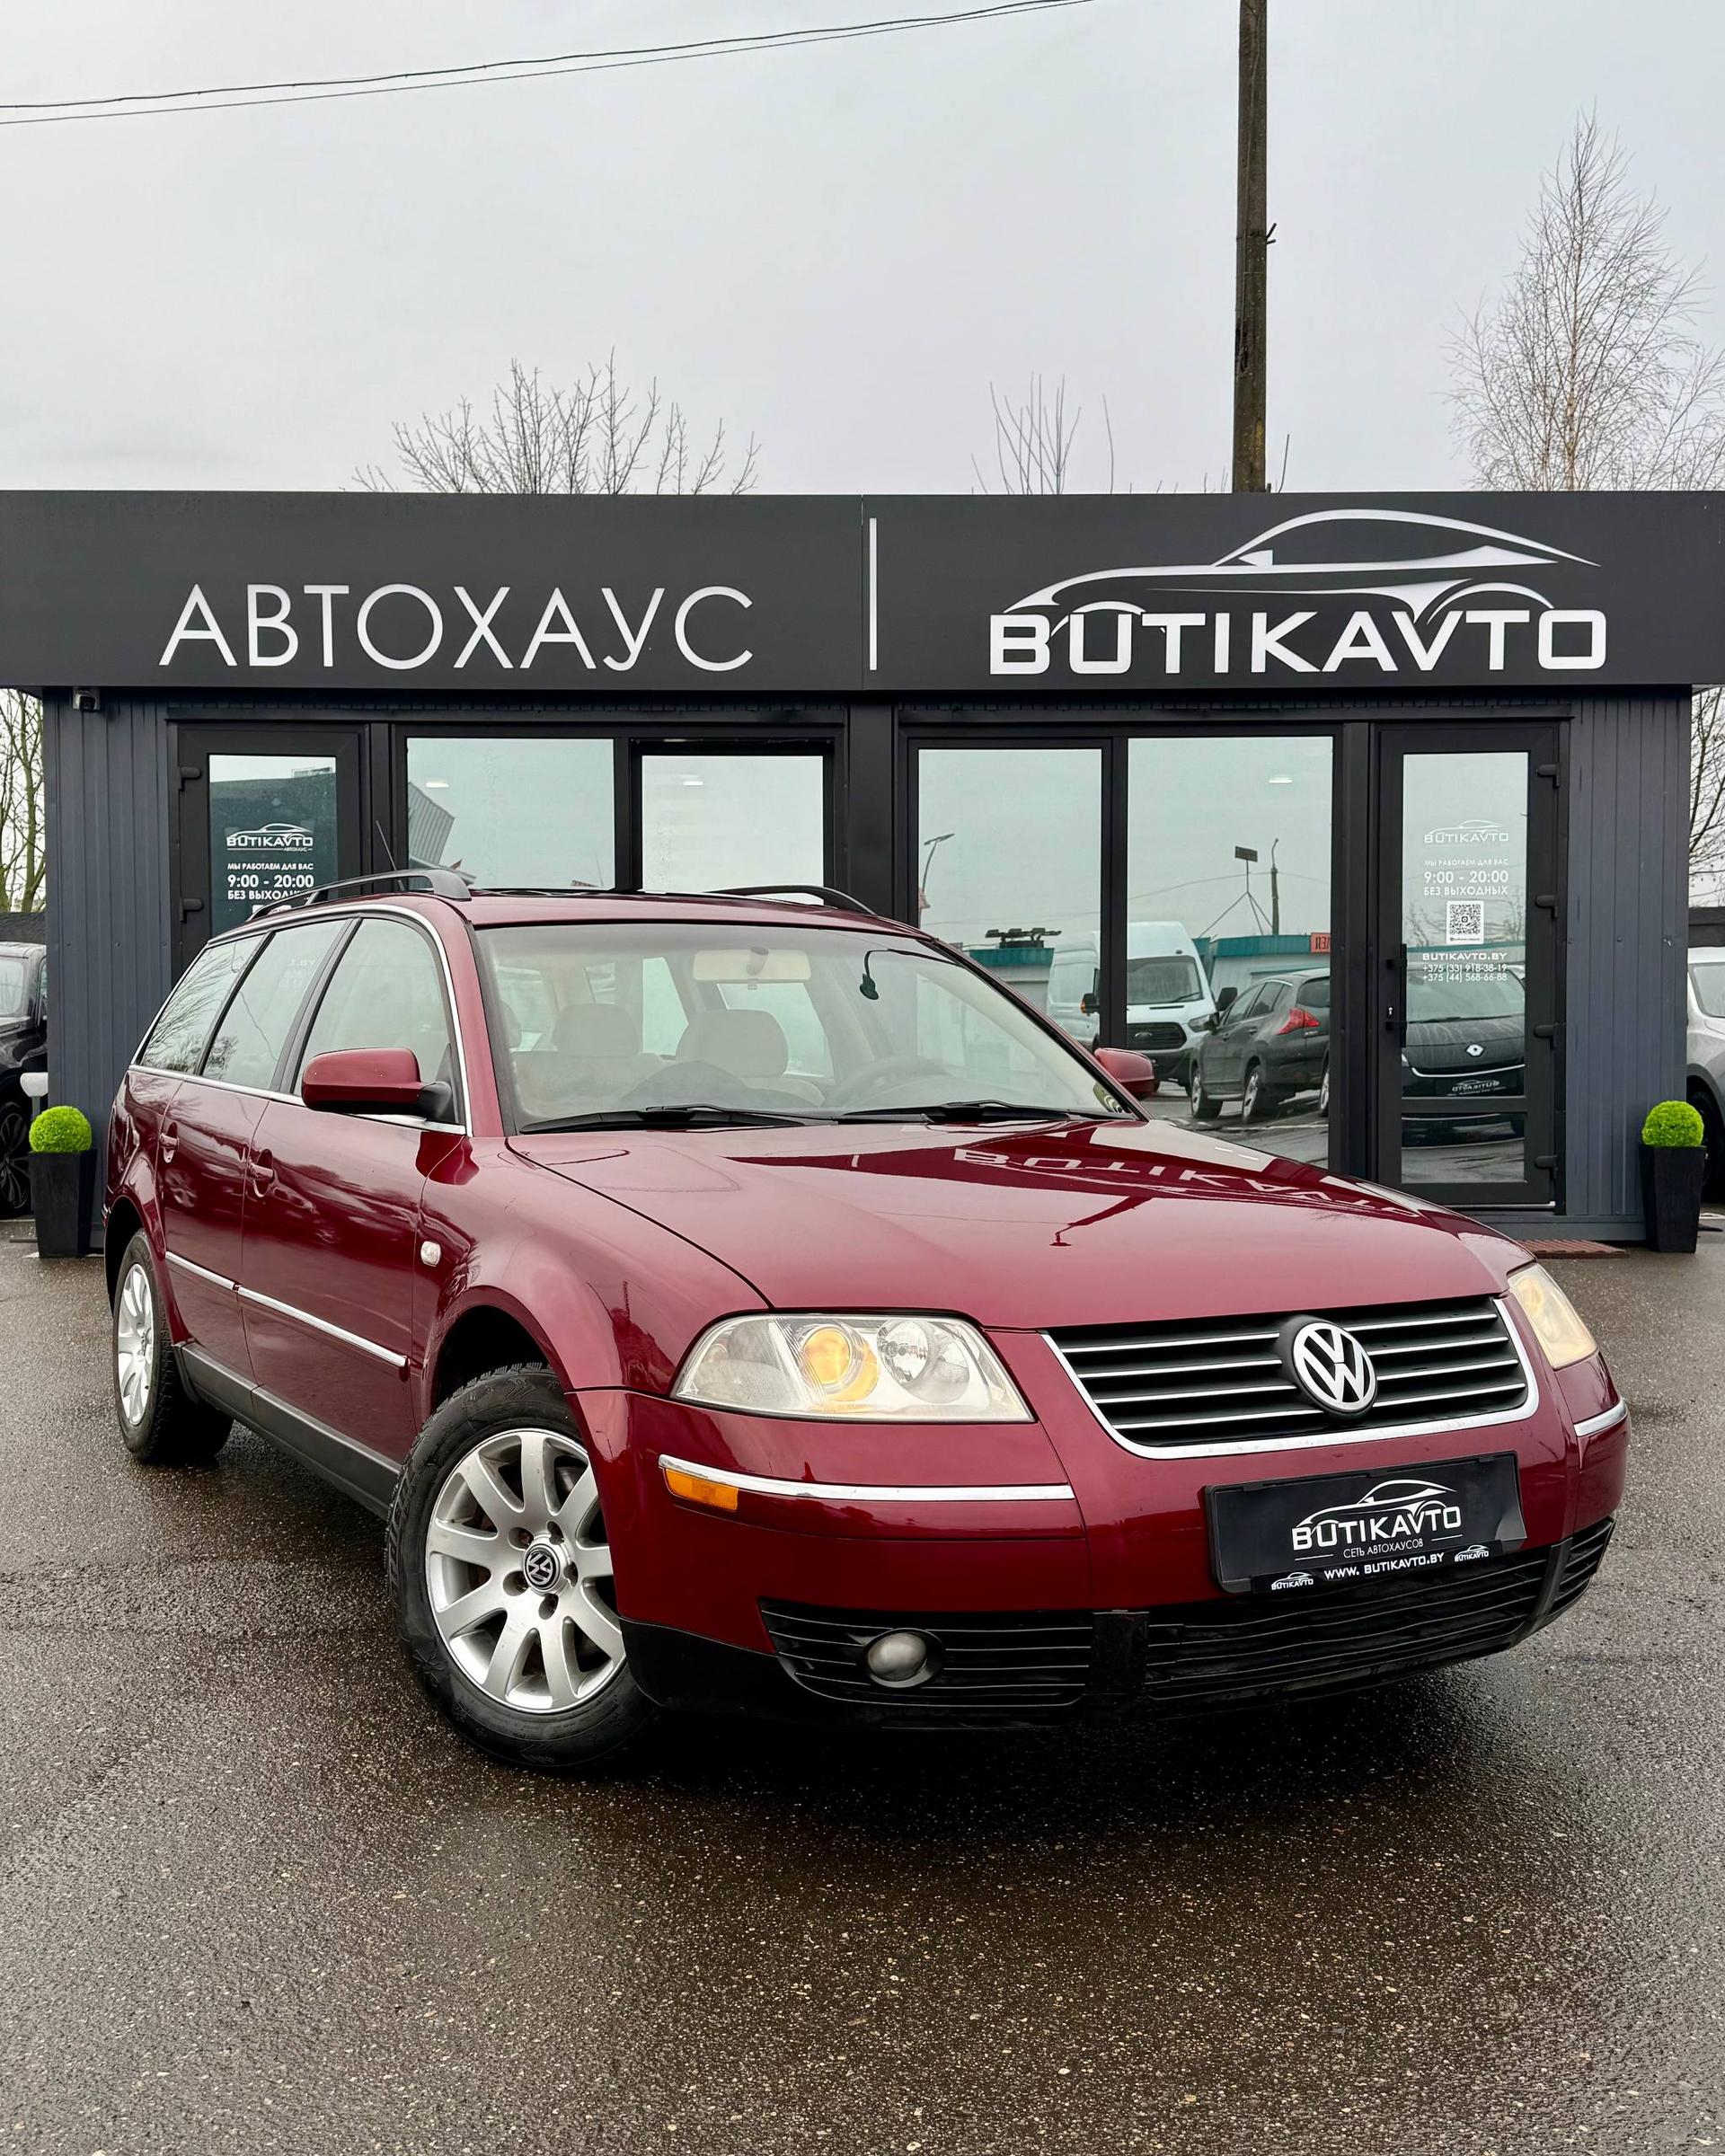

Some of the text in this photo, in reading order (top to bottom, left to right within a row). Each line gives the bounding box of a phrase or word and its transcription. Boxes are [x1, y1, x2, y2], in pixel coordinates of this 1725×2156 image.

[158, 582, 754, 673] АВТОХАУС
[989, 608, 1607, 676] BUTIKAVTO
[226, 836, 314, 846] BUTIKAVTO
[1424, 833, 1508, 843] BUTIKAVTO
[227, 874, 259, 888] 9:00
[273, 874, 314, 888] 20:00
[1424, 871, 1454, 884] 9:00
[1469, 870, 1508, 883] 20:00
[227, 890, 246, 899] БЕЗ
[1423, 886, 1508, 896] БЕЗ ВЫХОДНЫХ
[1422, 952, 1508, 961] BUTIKAVTO.BY
[1422, 963, 1508, 974] +375 (33) 918-38-19
[1422, 973, 1508, 983] +375 (44) 568-66-88
[1292, 1506, 1462, 1551] BUTIKAVTO
[1343, 1538, 1424, 1559] СЕТЬ АВТОХАУСОВ
[1455, 1551, 1490, 1562] BUTIKAVTO
[1323, 1552, 1445, 1580] WWW. BUTIKAVTO.BY
[1271, 1578, 1314, 1591] BUTIKAVTO
